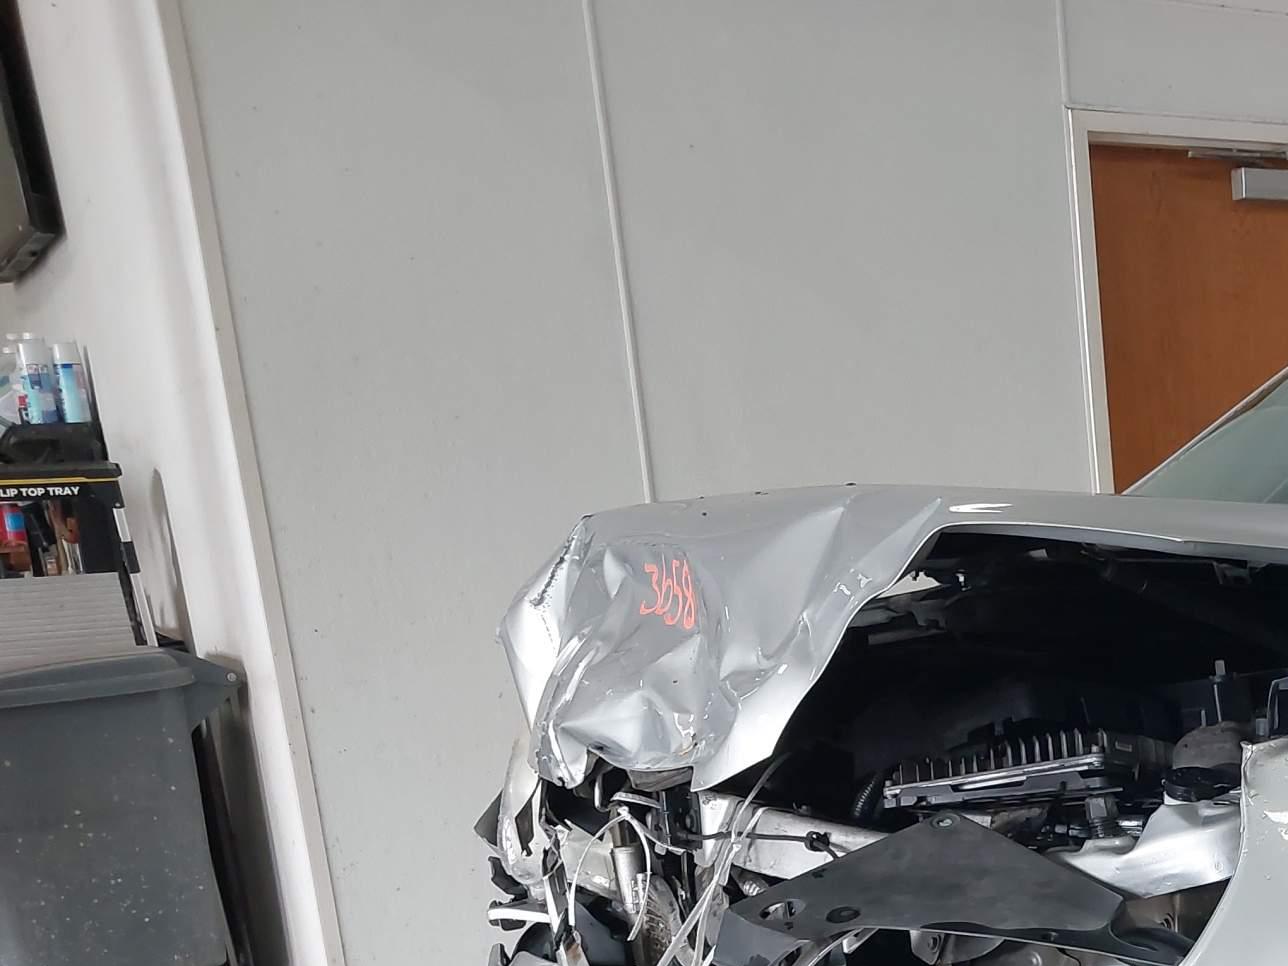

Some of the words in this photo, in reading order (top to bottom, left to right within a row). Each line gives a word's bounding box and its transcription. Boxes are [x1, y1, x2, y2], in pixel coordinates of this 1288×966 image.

[20, 487, 46, 497] TOP
[46, 486, 80, 497] TRAY
[640, 553, 697, 630] 3658
